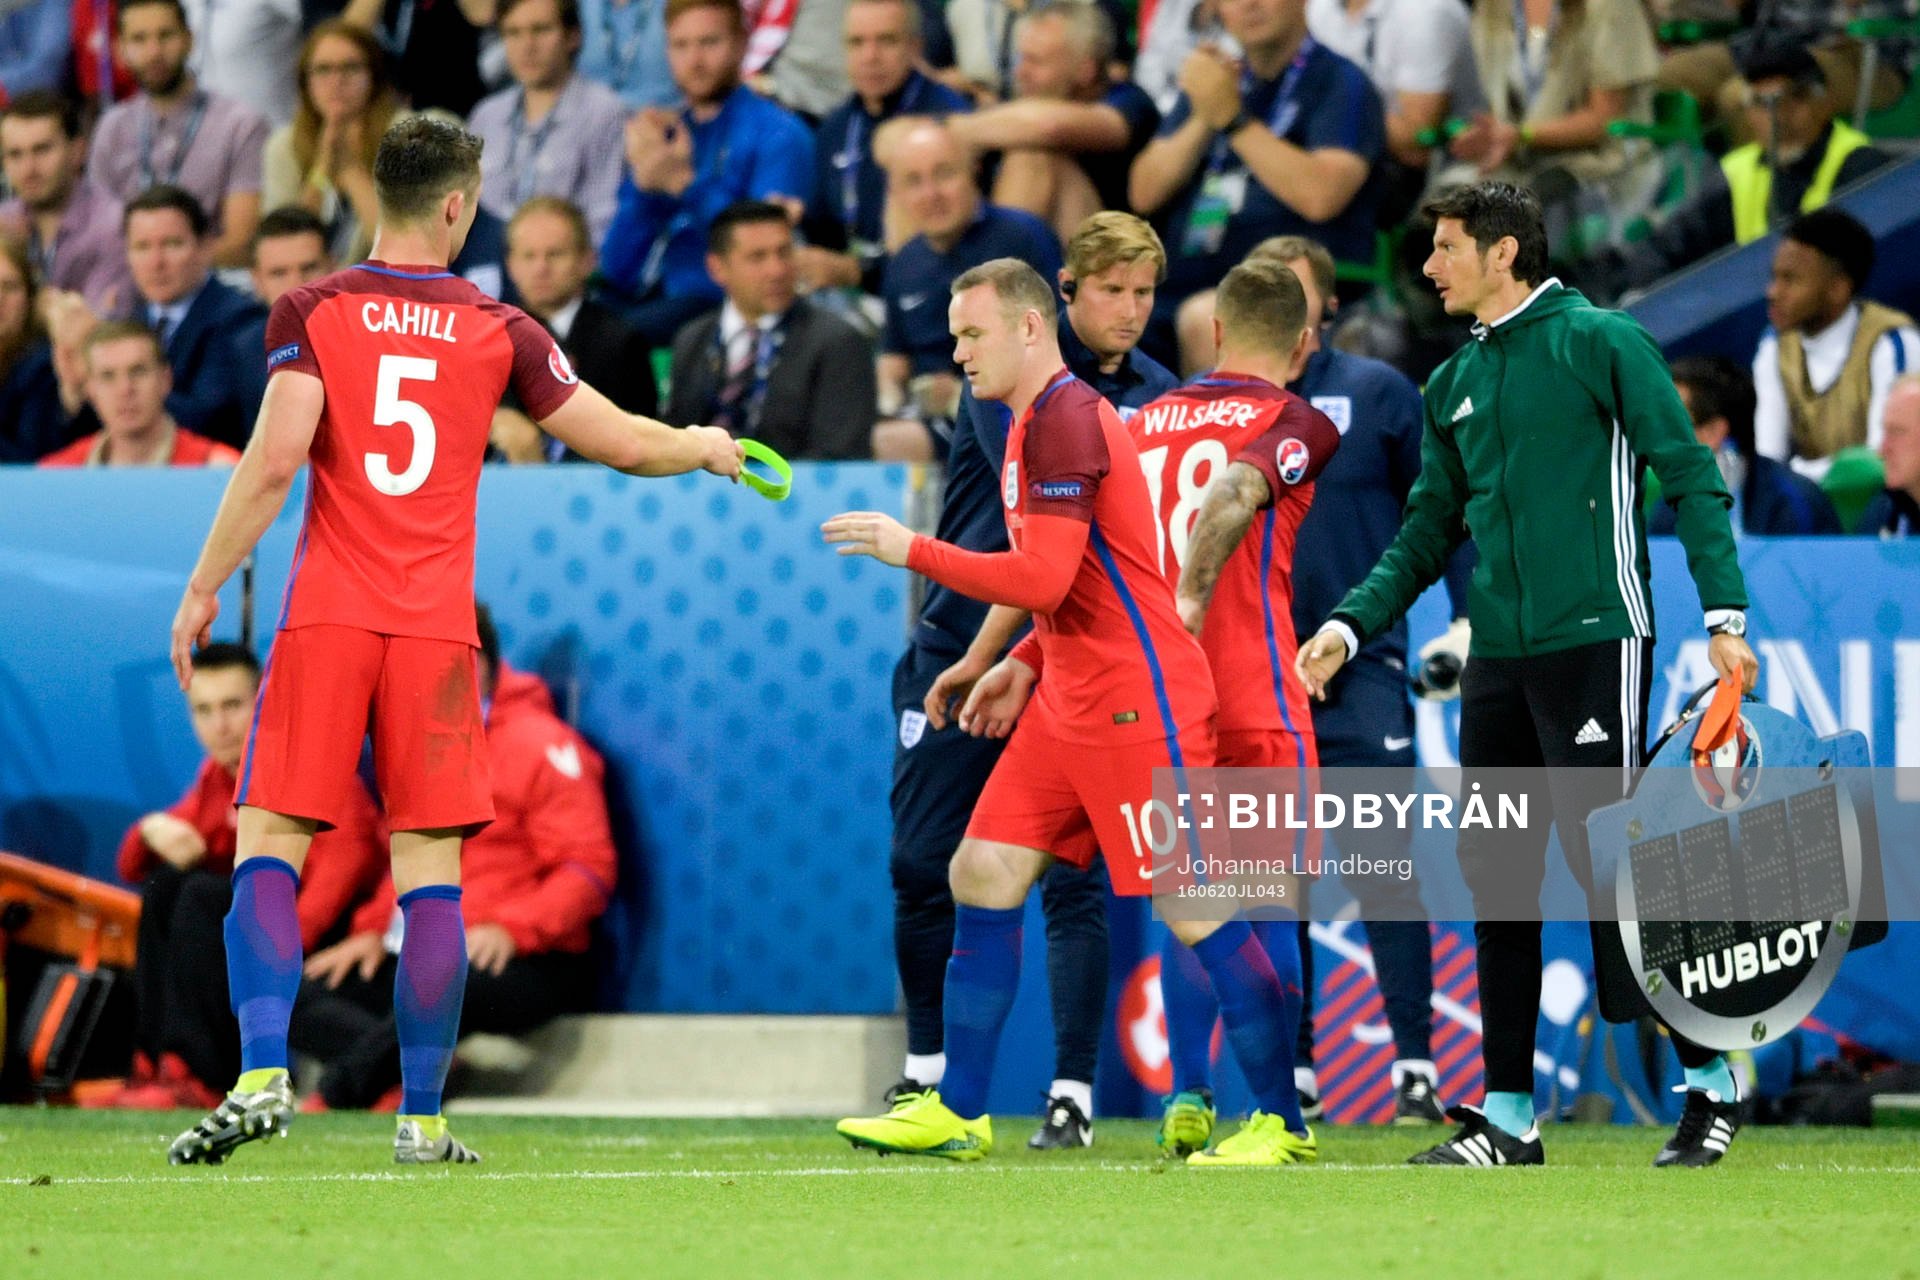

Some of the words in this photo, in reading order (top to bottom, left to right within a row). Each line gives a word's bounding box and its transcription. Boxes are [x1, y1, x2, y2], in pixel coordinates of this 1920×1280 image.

[361, 302, 456, 343] CAHILL
[364, 354, 438, 496] 5
[1043, 486, 1081, 497] RESPECT
[1575, 731, 1609, 745] adidas
[1120, 798, 1178, 858] 10
[1680, 920, 1822, 999] HUBLOT
